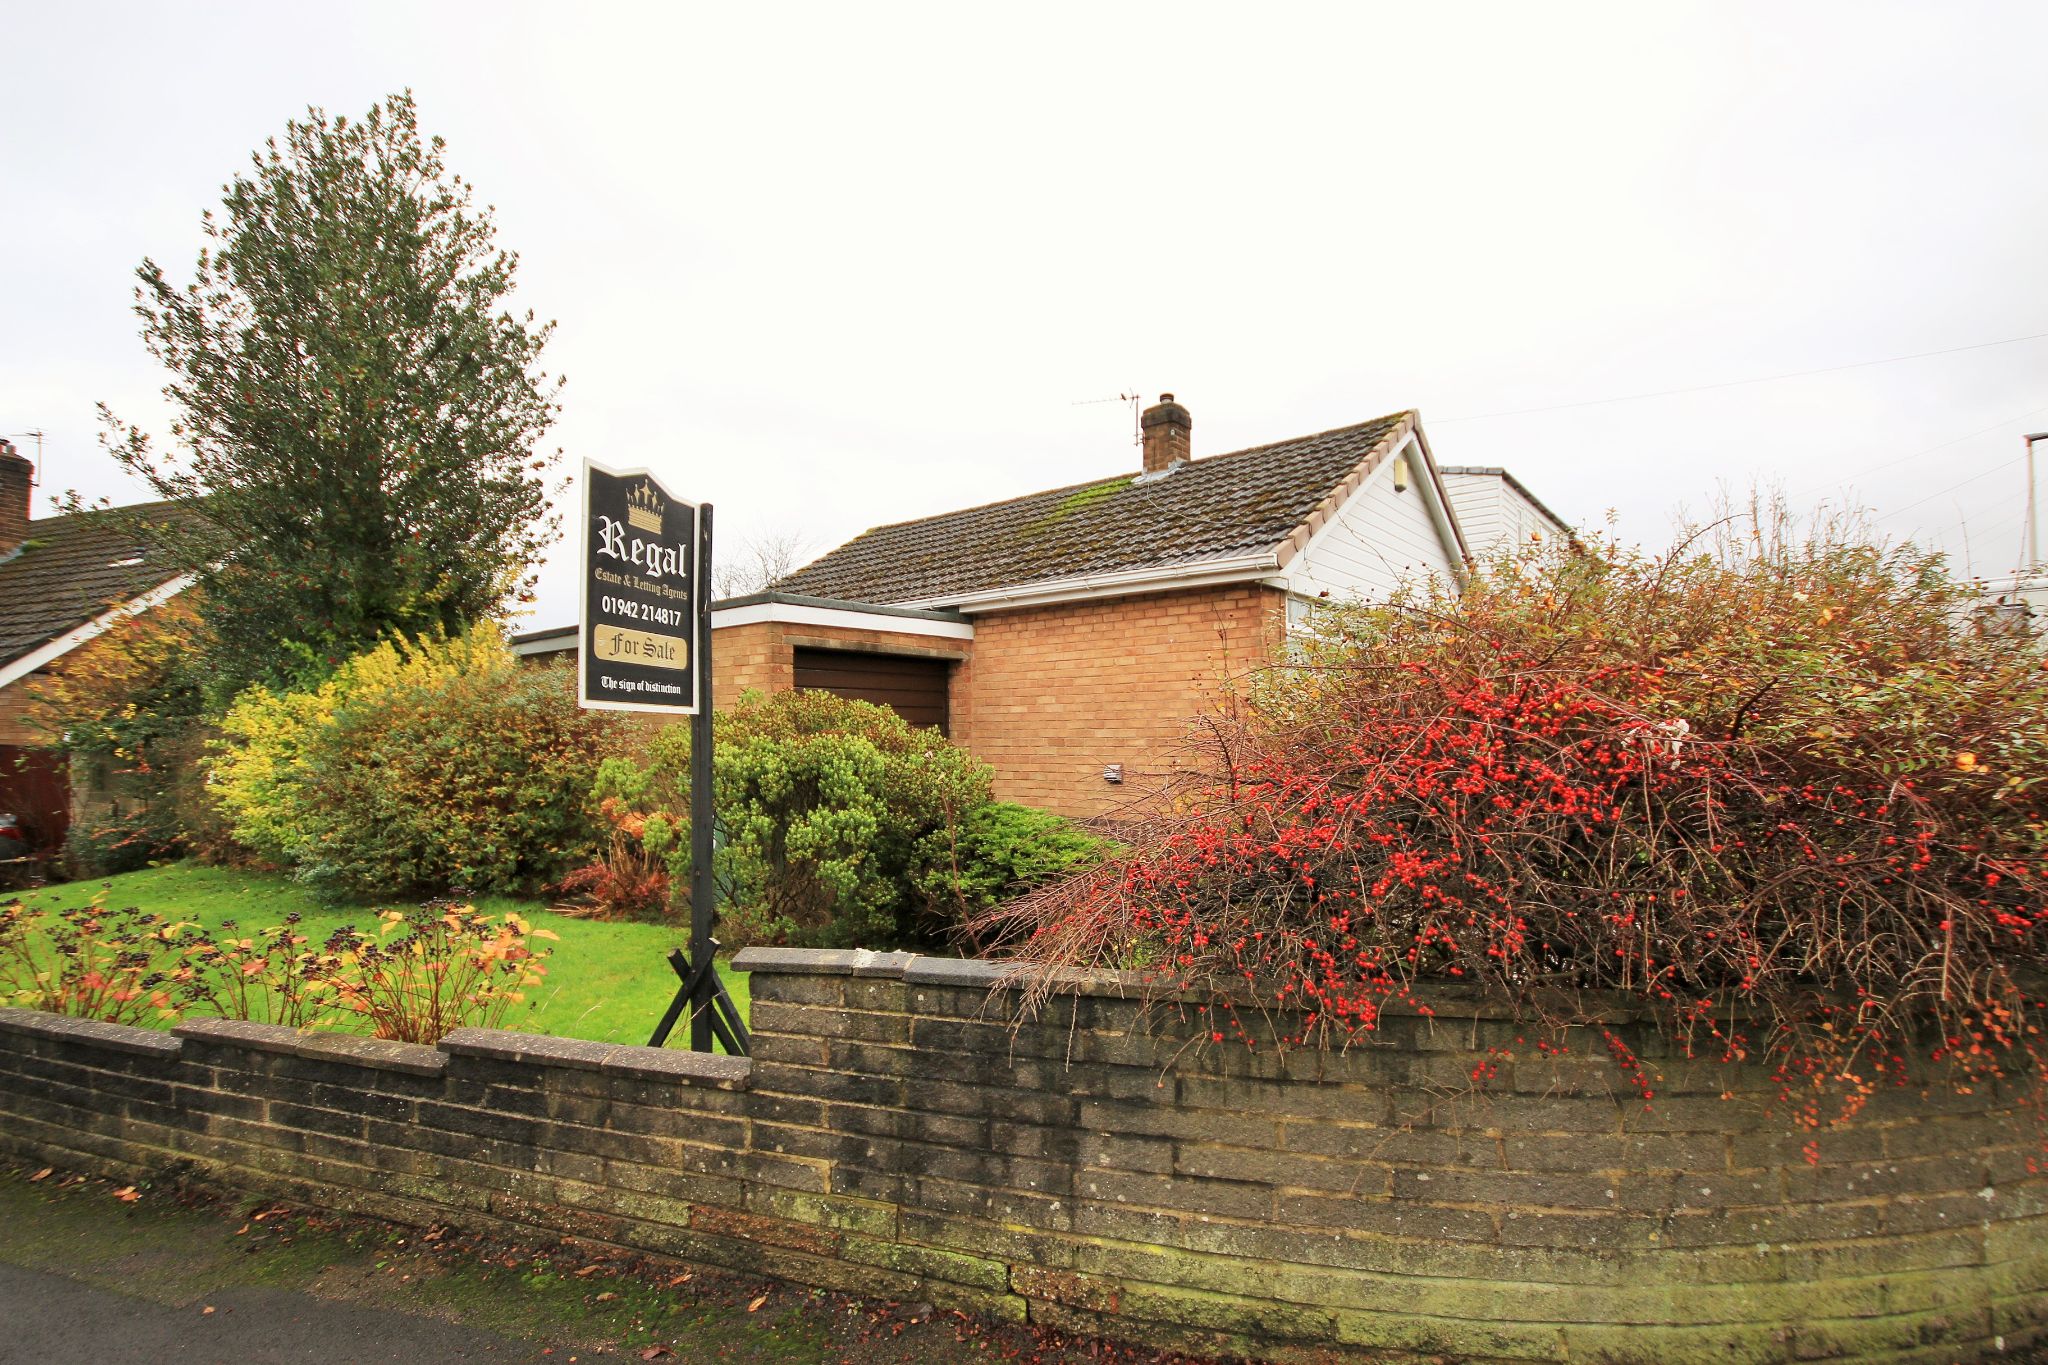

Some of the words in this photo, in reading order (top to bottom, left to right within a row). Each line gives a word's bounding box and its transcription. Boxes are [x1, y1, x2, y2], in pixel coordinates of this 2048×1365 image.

[597, 515, 686, 578] Regal
[595, 567, 621, 584] Estate
[623, 574, 631, 587] &
[633, 576, 660, 595] Letting
[662, 584, 687, 599] Agents
[602, 595, 638, 619] 01942
[641, 604, 680, 626] 214817
[609, 632, 639, 656] For
[643, 637, 675, 661] Sale
[601, 676, 617, 689] The
[619, 680, 635, 691] sign
[636, 680, 645, 691] of
